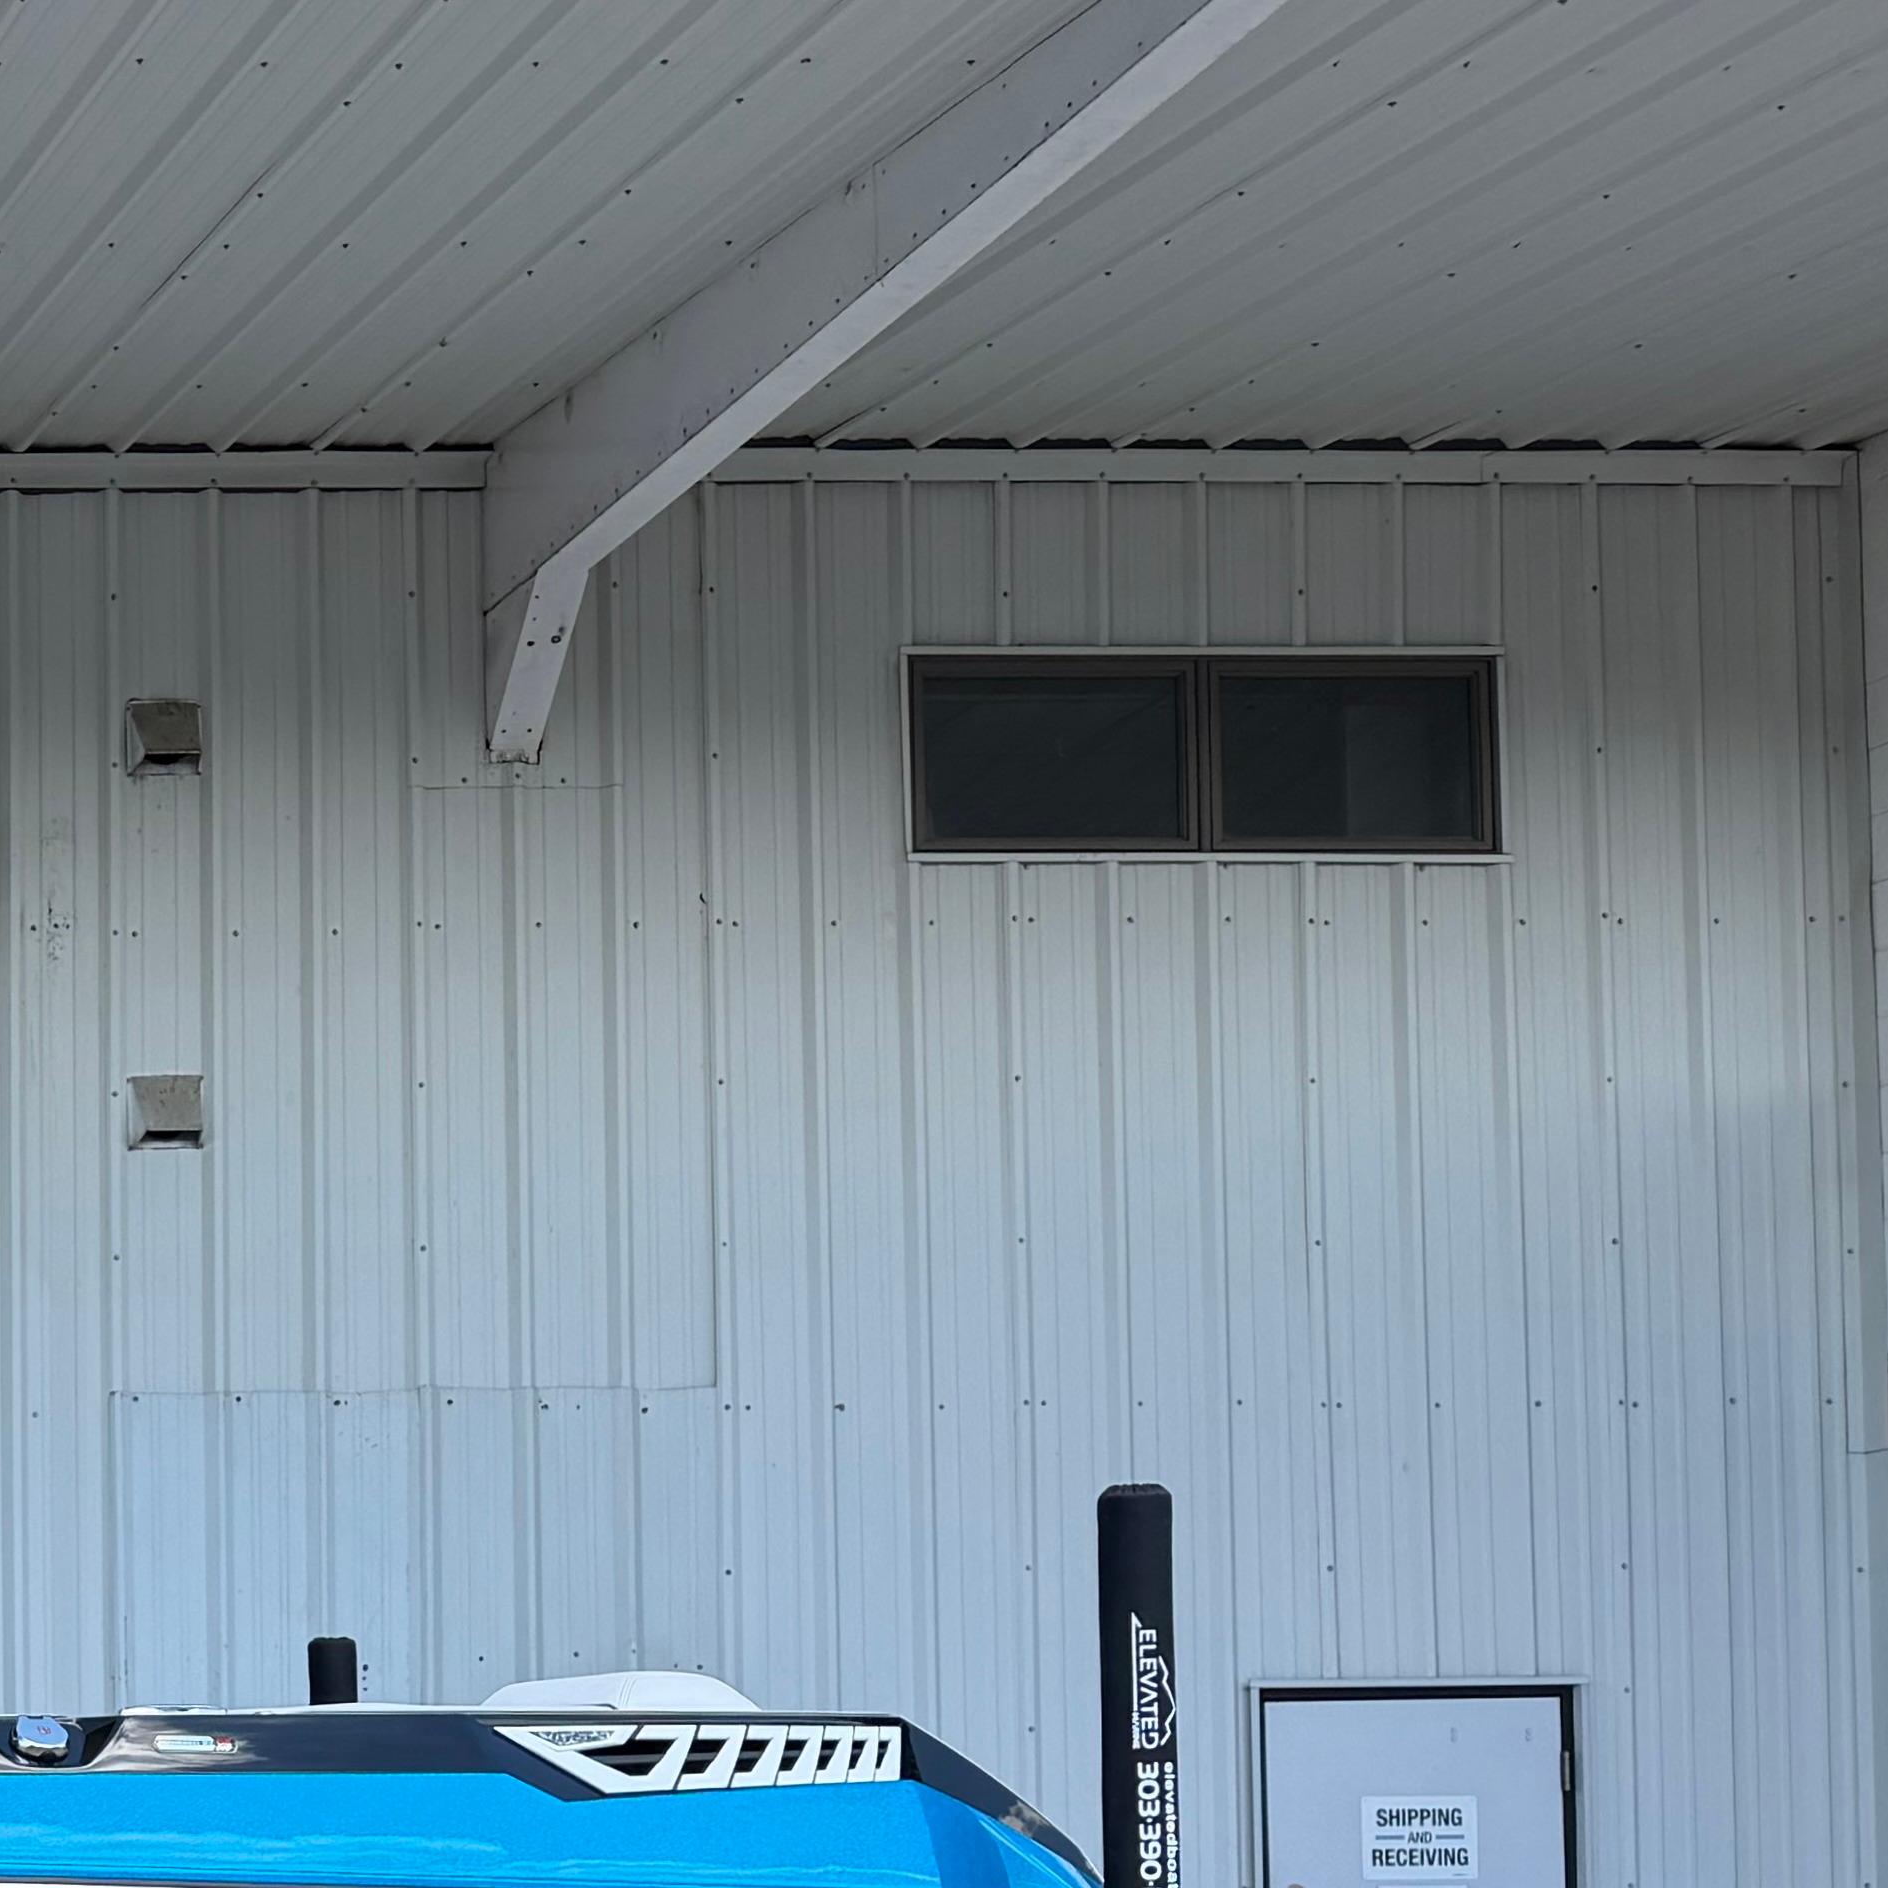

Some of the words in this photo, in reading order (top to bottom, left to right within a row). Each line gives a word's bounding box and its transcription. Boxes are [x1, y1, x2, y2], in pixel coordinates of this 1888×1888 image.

[1138, 1627, 1159, 1750] ELEVATED
[1375, 1807, 1463, 1828] SHIPPING
[1407, 1831, 1433, 1845] AND
[1371, 1847, 1470, 1868] RECEIVING
